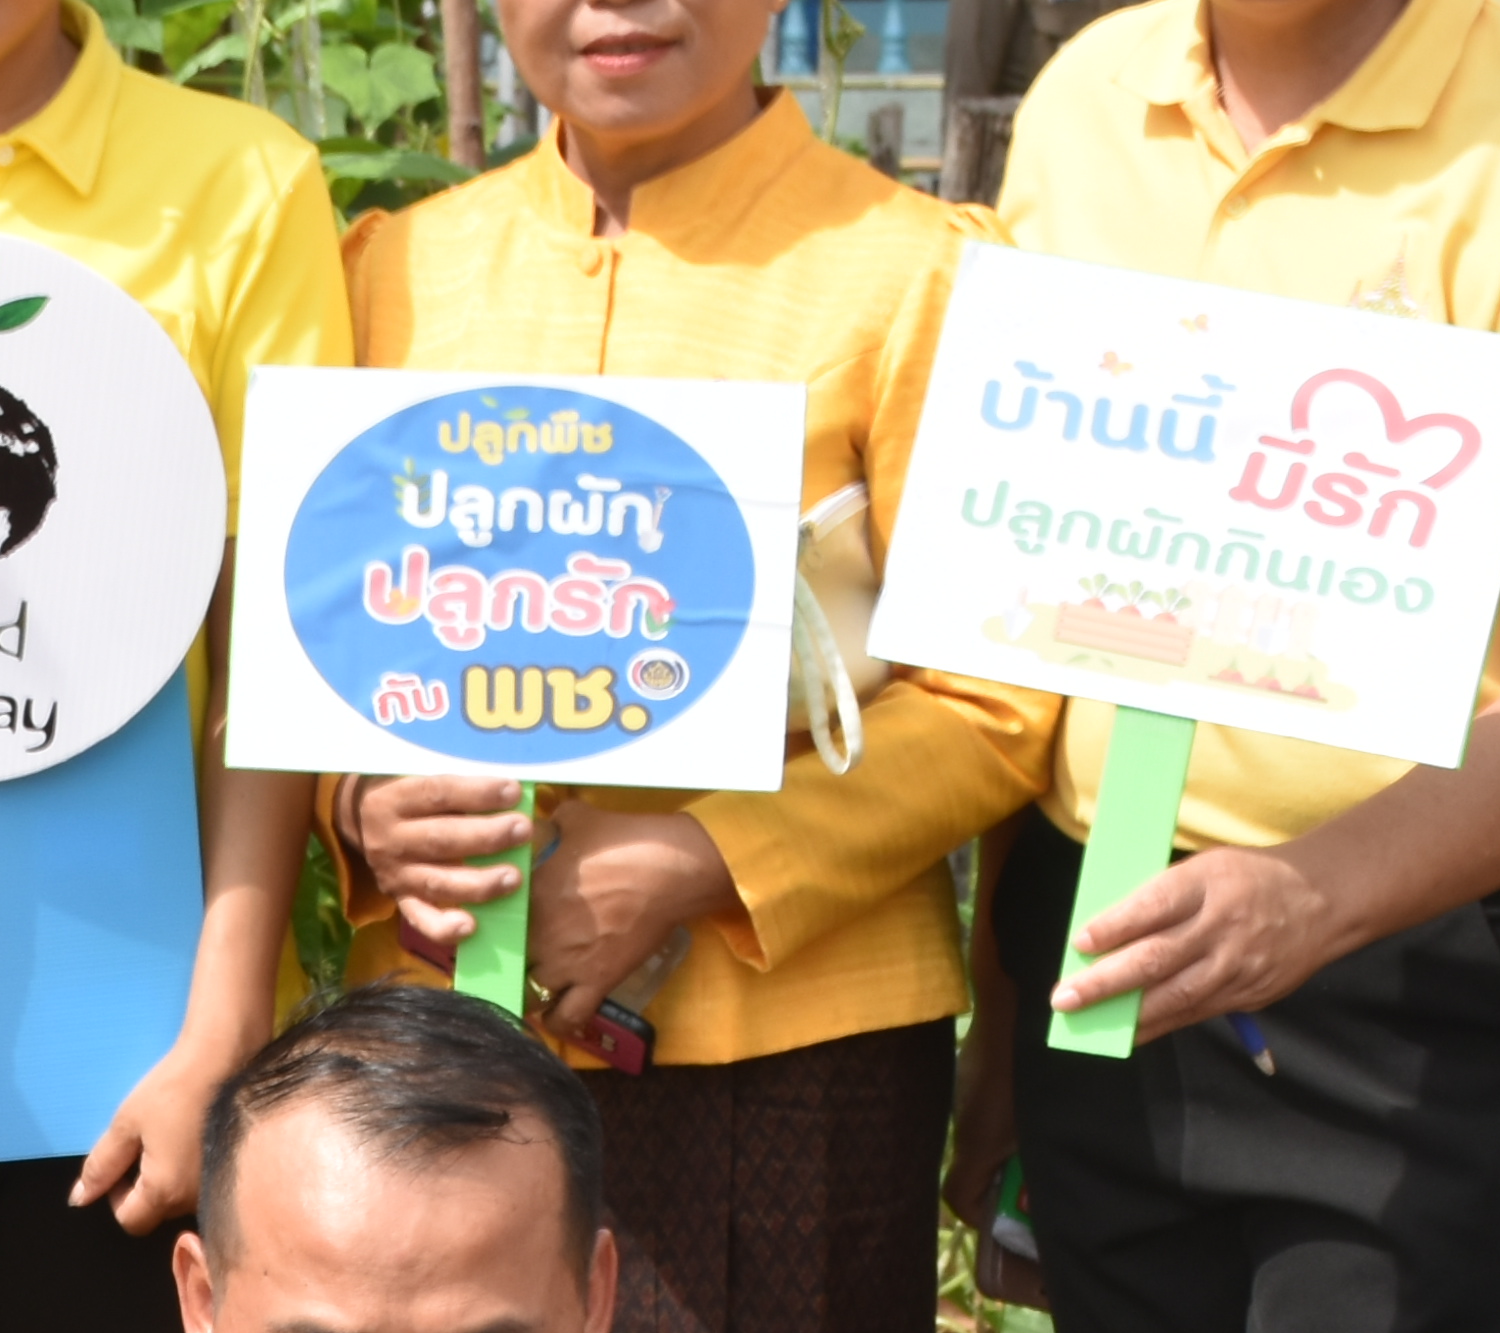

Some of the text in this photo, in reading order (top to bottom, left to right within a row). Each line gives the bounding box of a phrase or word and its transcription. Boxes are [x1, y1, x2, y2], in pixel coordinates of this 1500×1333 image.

[439, 411, 612, 464] ปลูกพืช
[980, 359, 1437, 548] บ้านนี้ มีรัก
[402, 470, 655, 547] ปลูกผัก
[960, 481, 1435, 614] ปลูกผักกินเอง
[364, 544, 671, 651] ปลูกรัก
[373, 663, 650, 733] กับ พช.
